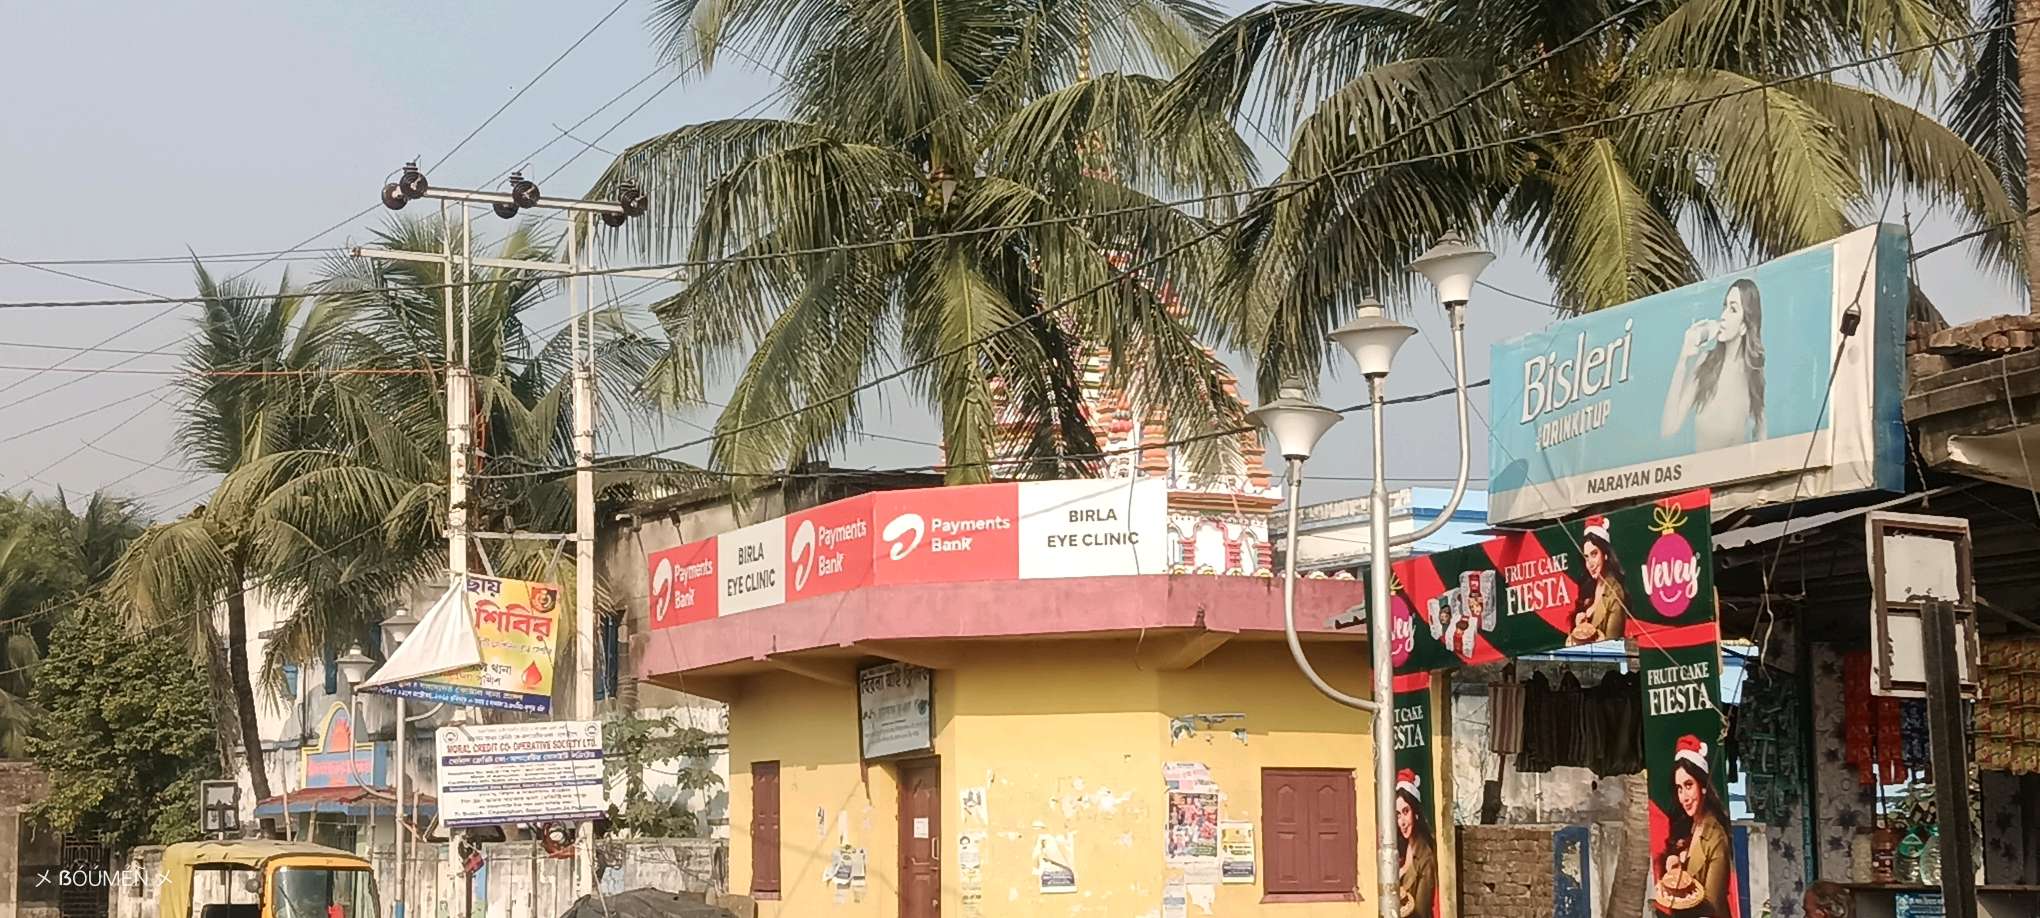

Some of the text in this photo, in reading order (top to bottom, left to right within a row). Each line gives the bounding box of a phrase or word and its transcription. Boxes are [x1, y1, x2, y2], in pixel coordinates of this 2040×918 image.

[1520, 318, 1633, 425] Bisleri
[1587, 464, 1682, 495] NARAYAN DAS
[931, 515, 1010, 533] Payments
[1069, 508, 1117, 522] BIRLA
[818, 520, 866, 551] Payments
[931, 537, 972, 553] Bank
[1047, 531, 1139, 547] EYE CLINIC
[737, 541, 765, 566] BIRLA
[818, 553, 845, 577] Bank
[673, 558, 714, 584] Payments
[1504, 553, 1568, 583] FRUIT CAKE
[727, 568, 775, 597] EYE CLINIC
[673, 588, 696, 610] Bank
[1506, 574, 1571, 617] FIESTA
[475, 599, 552, 641] শিবির
[1647, 662, 1709, 685] FRUIT CAKE
[1648, 682, 1712, 716] FIESTA
[1401, 705, 1424, 722] CAKE
[473, 742, 498, 752] CREDIT
[513, 739, 551, 751] OPERATIVE
[552, 738, 581, 749] SOCIETY
